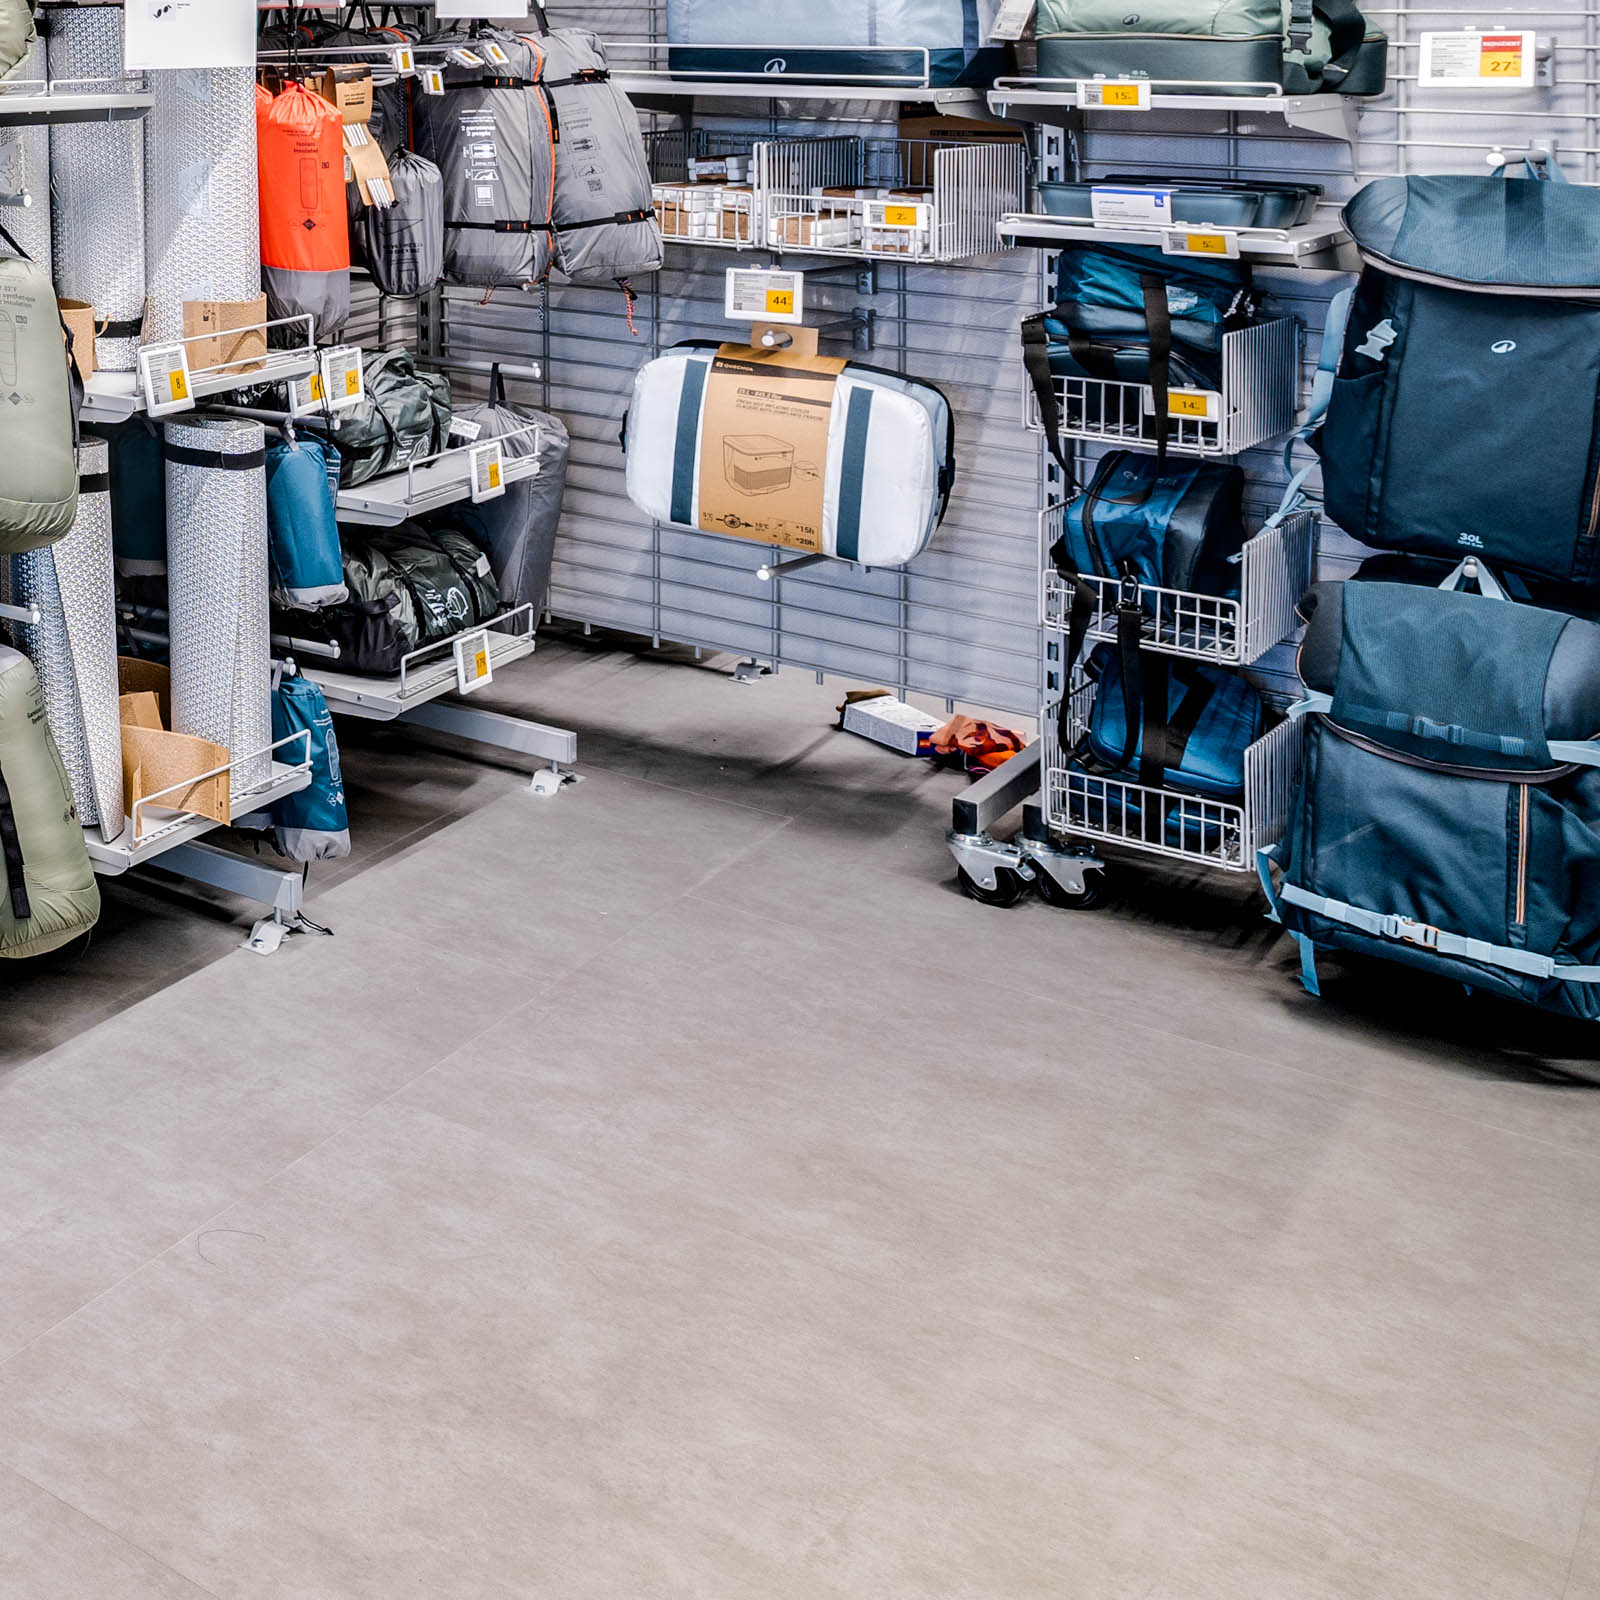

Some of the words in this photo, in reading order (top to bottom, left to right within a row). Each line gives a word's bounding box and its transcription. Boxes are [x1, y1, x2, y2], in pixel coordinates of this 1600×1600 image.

[1490, 61, 1511, 72] 27
[773, 297, 787, 305] 44
[1459, 532, 1483, 544] 30L
